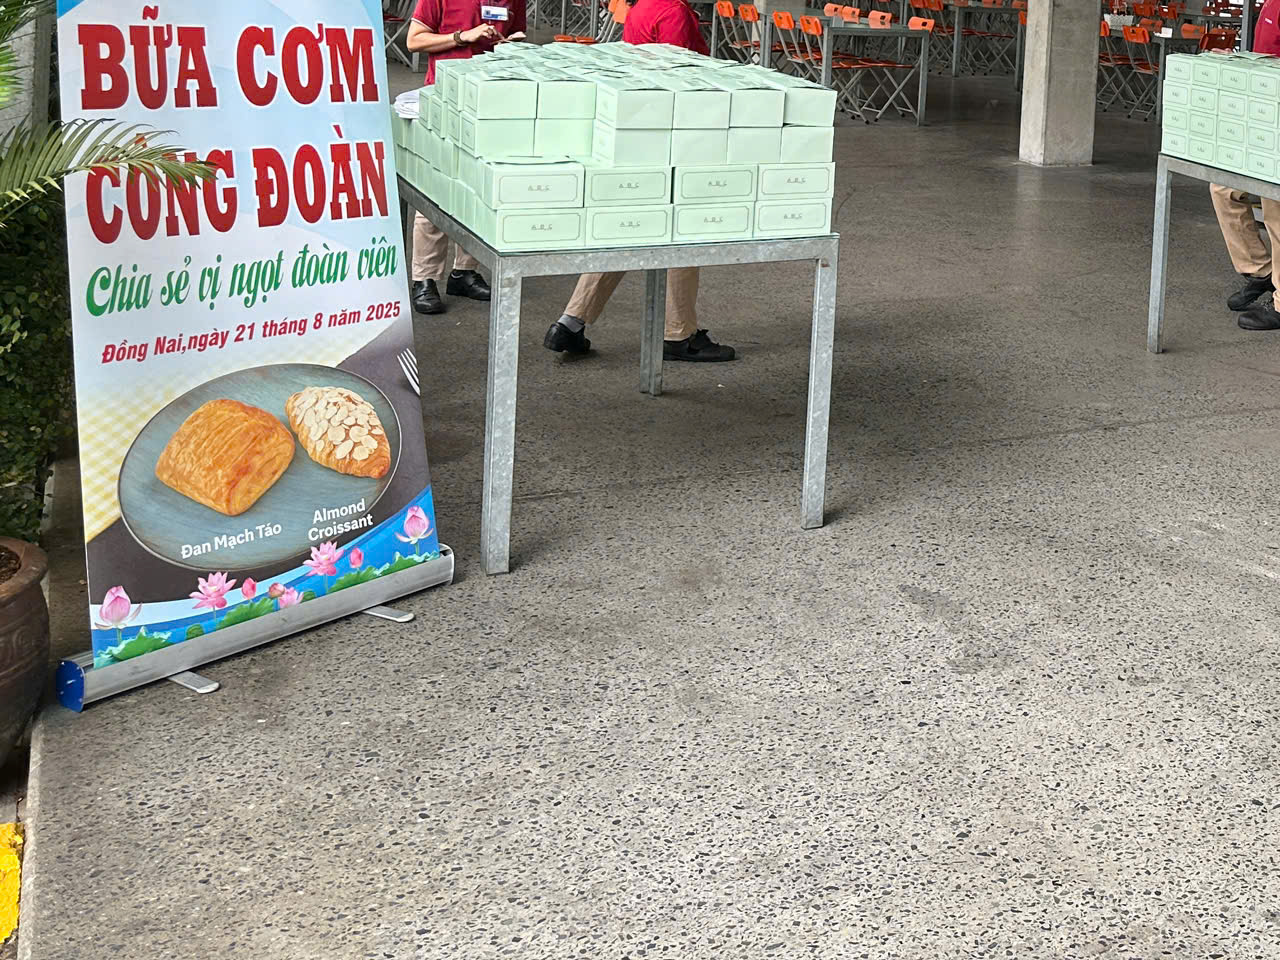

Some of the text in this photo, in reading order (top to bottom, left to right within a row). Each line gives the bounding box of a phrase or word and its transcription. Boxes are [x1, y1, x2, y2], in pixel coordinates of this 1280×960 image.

[77, 5, 379, 110] BỮA CƠM
[253, 124, 389, 229] ĐOÀN
[86, 236, 398, 317] Chia sẻ vị ngọt đoàn viên
[102, 340, 148, 364] Đồng
[234, 323, 255, 342] 21
[263, 315, 307, 339] tháng
[312, 315, 323, 330] 8
[328, 308, 361, 328] năm
[365, 301, 401, 322] 2025
[181, 522, 282, 559] Đan Mạch Táo
[308, 513, 374, 542] Croissant
[312, 498, 366, 525] Almond
